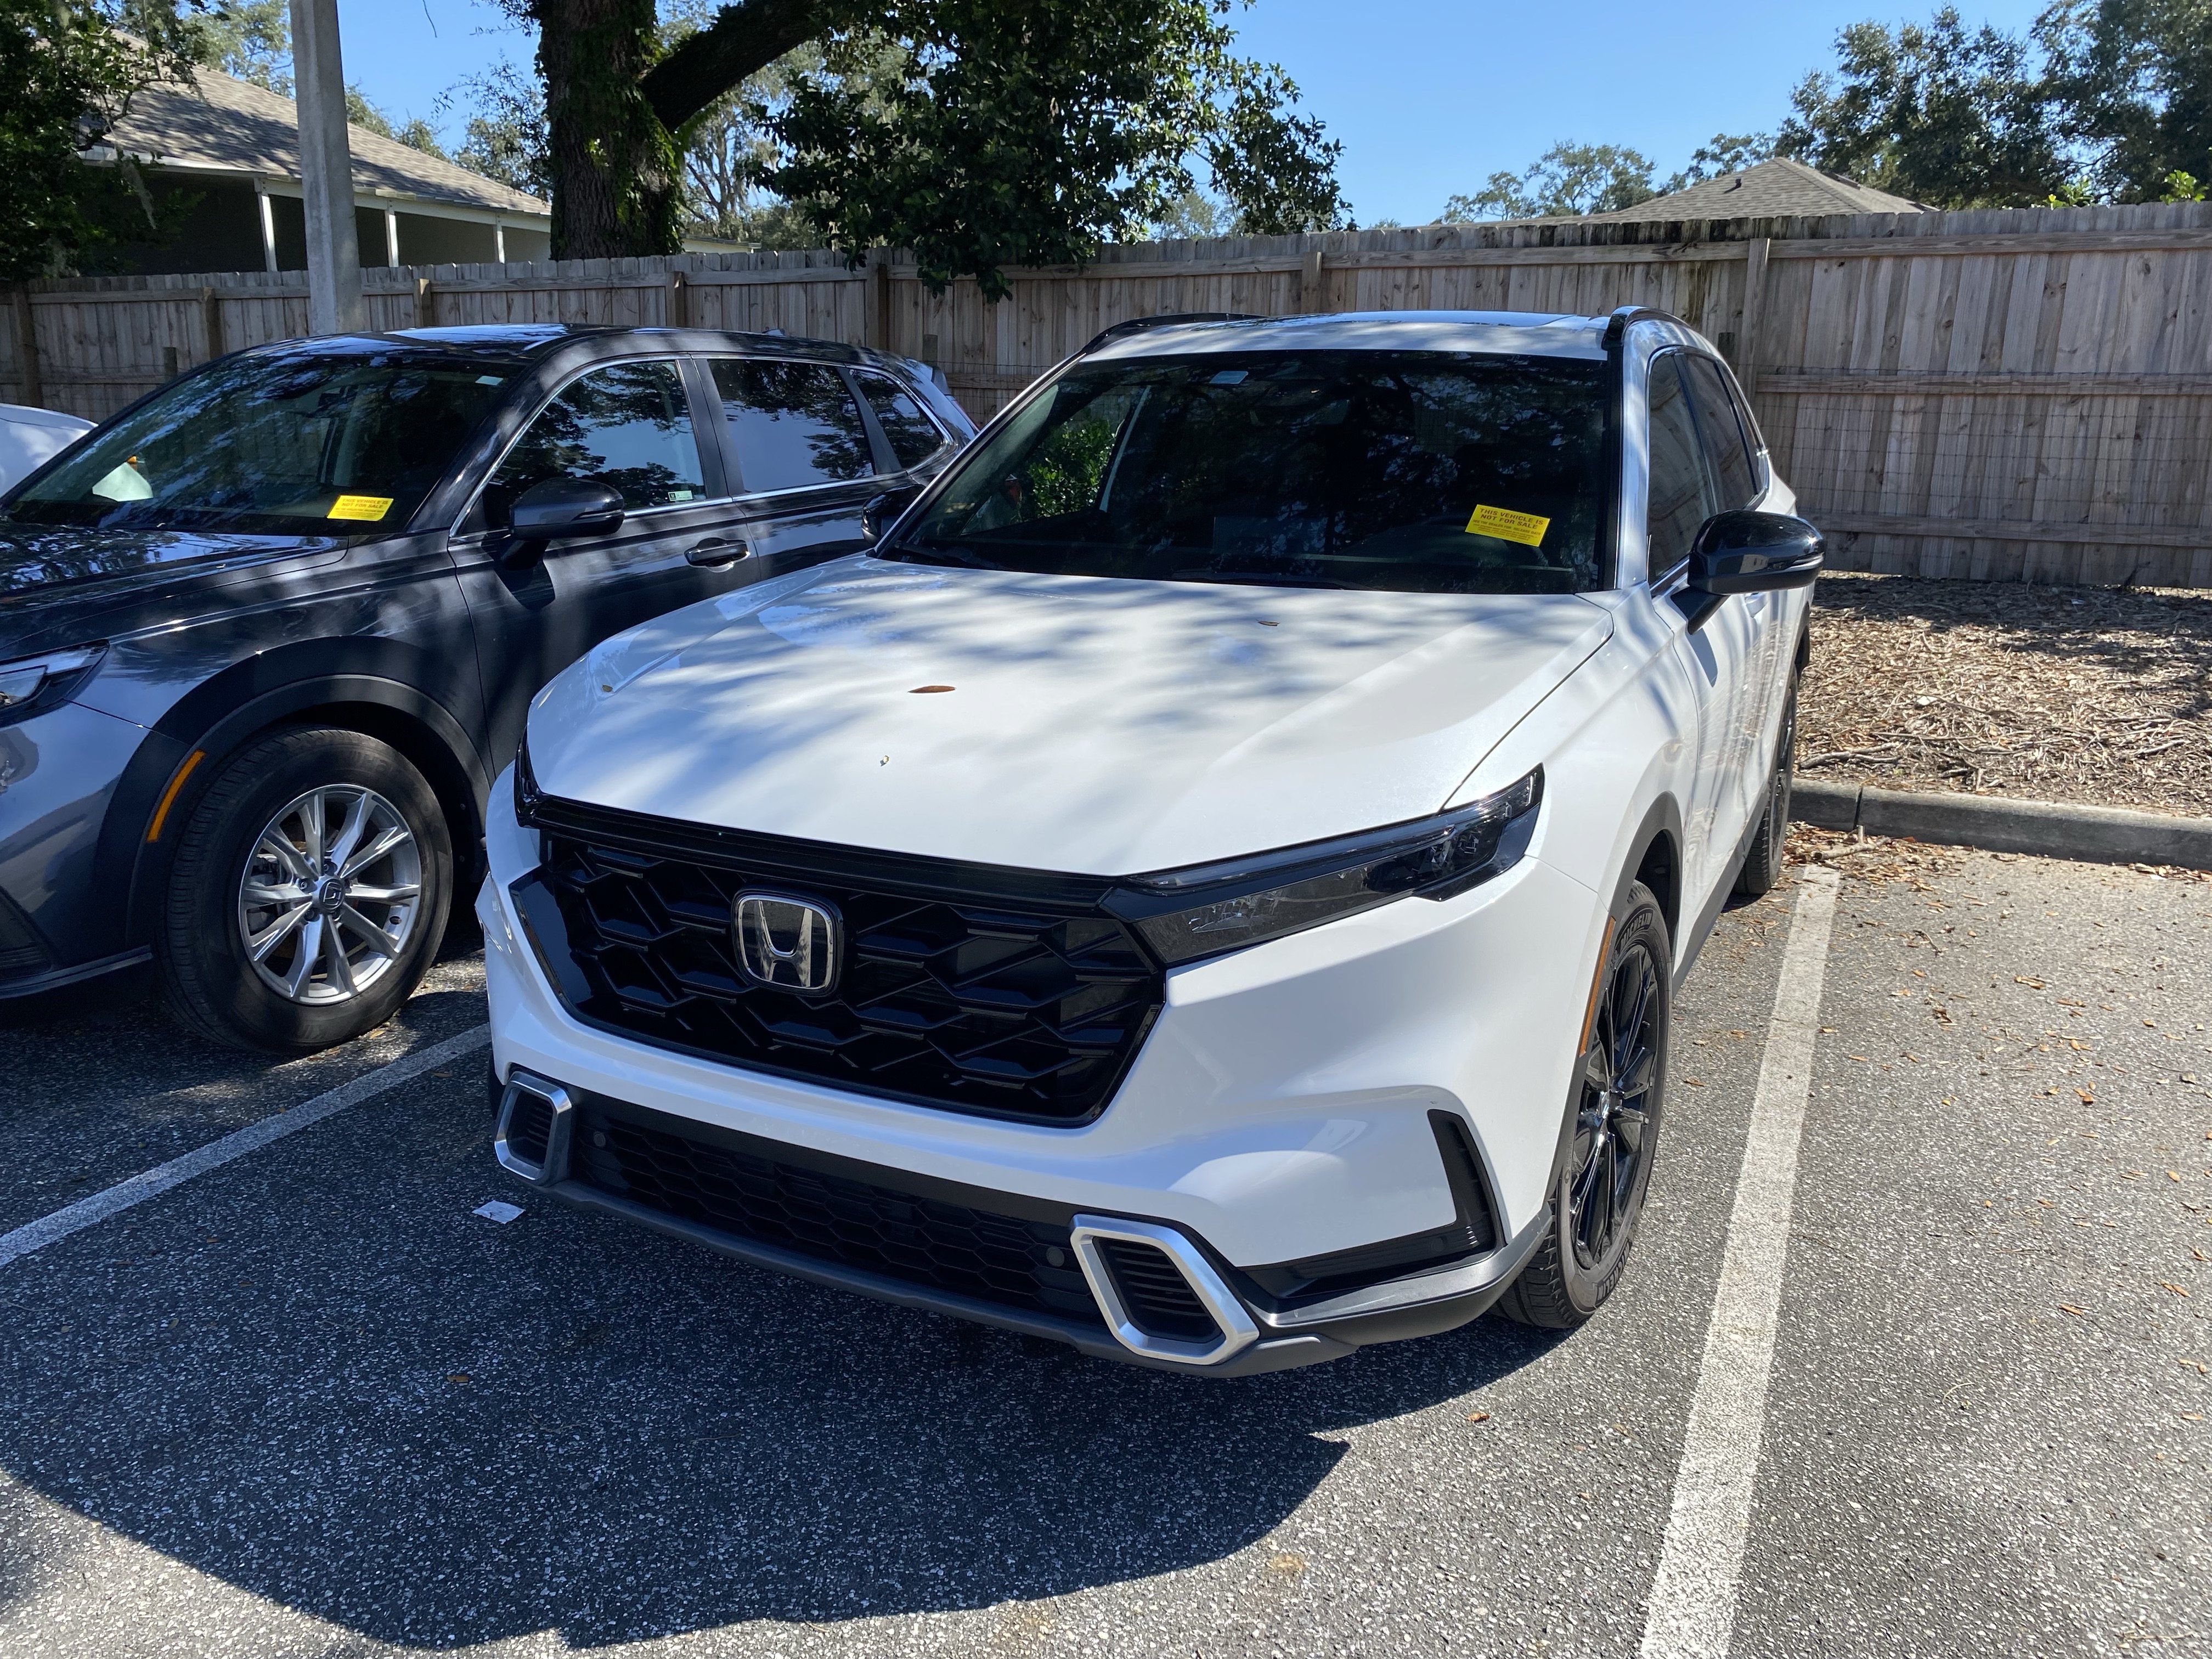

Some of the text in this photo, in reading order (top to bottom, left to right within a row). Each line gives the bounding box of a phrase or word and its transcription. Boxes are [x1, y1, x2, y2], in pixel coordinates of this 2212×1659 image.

[1480, 507, 1498, 516] THIS
[1500, 511, 1533, 523] VEHICLE
[1517, 521, 1538, 529] SALE
[1620, 912, 1652, 952] MICHELIN
